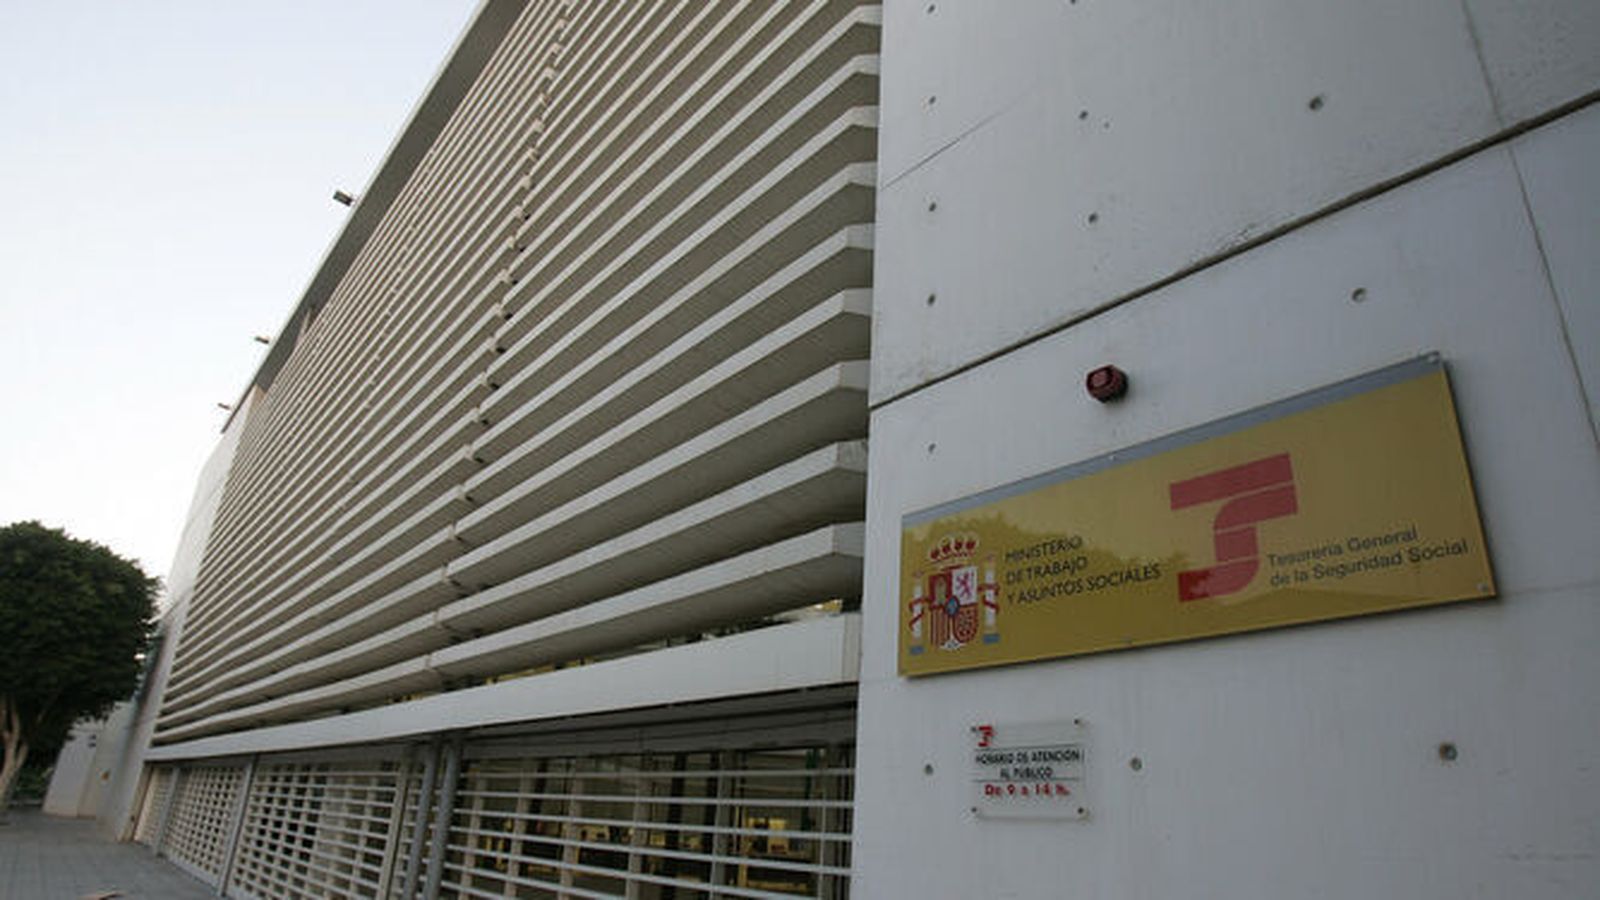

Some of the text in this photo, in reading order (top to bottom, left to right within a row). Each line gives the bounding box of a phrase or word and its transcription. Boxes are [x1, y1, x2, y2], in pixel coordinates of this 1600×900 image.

[1006, 536, 1082, 560] MINISTERIO
[1348, 526, 1418, 550] General
[1007, 557, 1087, 584] DE TRABAJO
[1270, 539, 1469, 587] de la Seguridad Social
[1007, 564, 1161, 604] Y ASUNTOS SOCIALES
